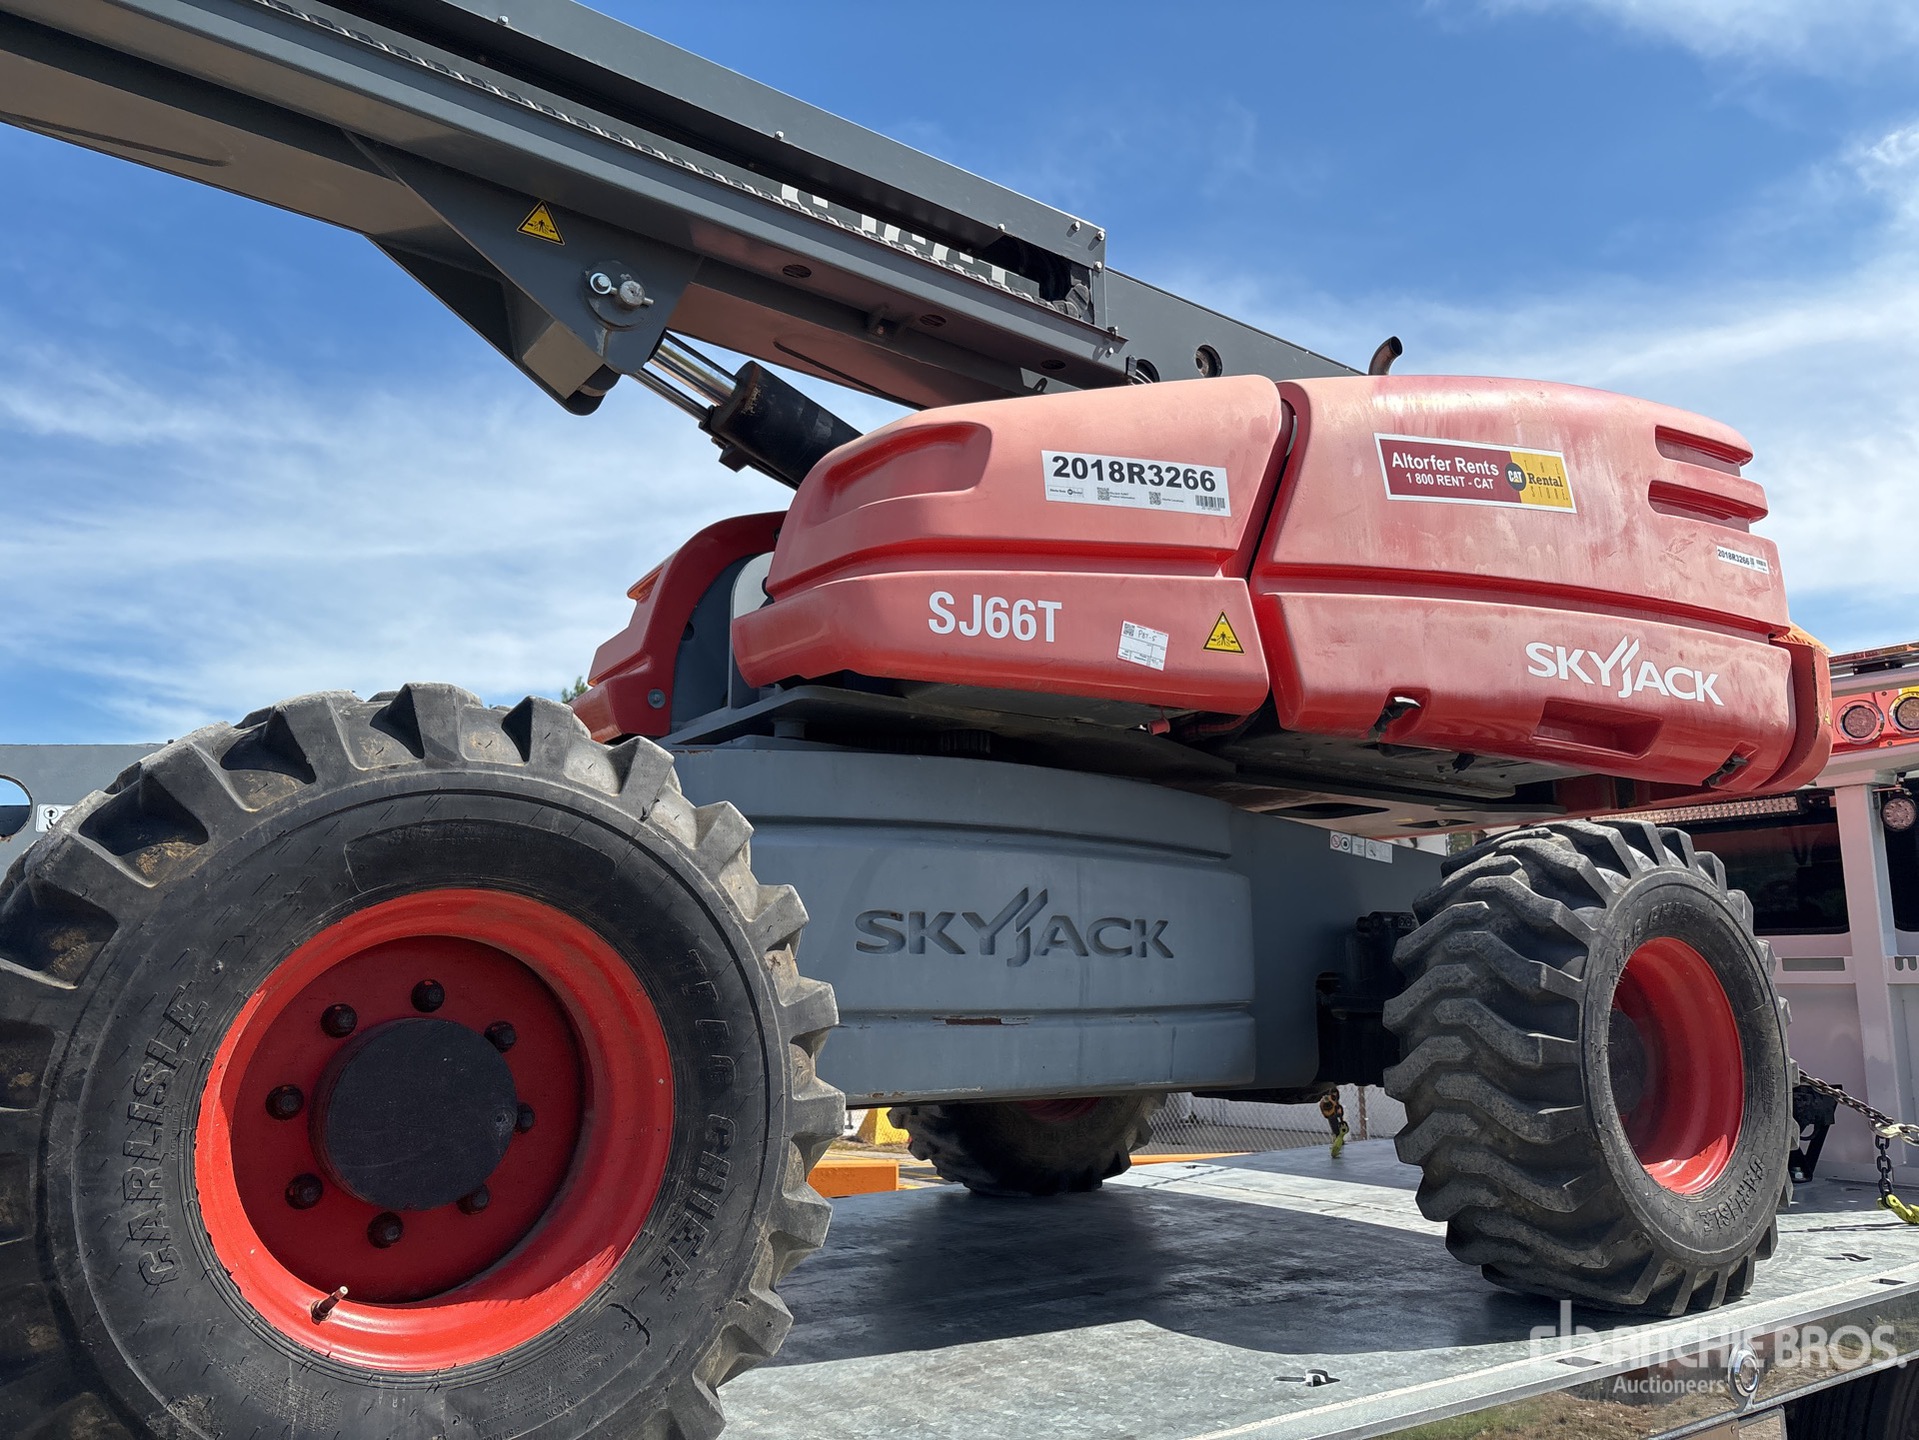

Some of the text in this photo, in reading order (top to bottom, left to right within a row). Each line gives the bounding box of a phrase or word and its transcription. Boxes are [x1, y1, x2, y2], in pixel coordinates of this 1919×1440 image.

[1052, 455, 1216, 492] 2018R3266
[1392, 452, 1499, 476] Altorfer Rents
[1405, 472, 1412, 484] 1
[1415, 474, 1434, 486] 800
[1437, 475, 1466, 488] RENT
[1474, 477, 1494, 490] CAT
[1507, 470, 1523, 484] CAT
[1526, 472, 1564, 488] Rental
[1717, 549, 1750, 566] 2018R3266
[928, 591, 1062, 642] SJ66T
[1525, 635, 1724, 706] SKYJACK
[855, 887, 1174, 967] SKYJACK
[123, 980, 210, 1288] CARLISLE
[663, 1112, 738, 1300] CHIEF
